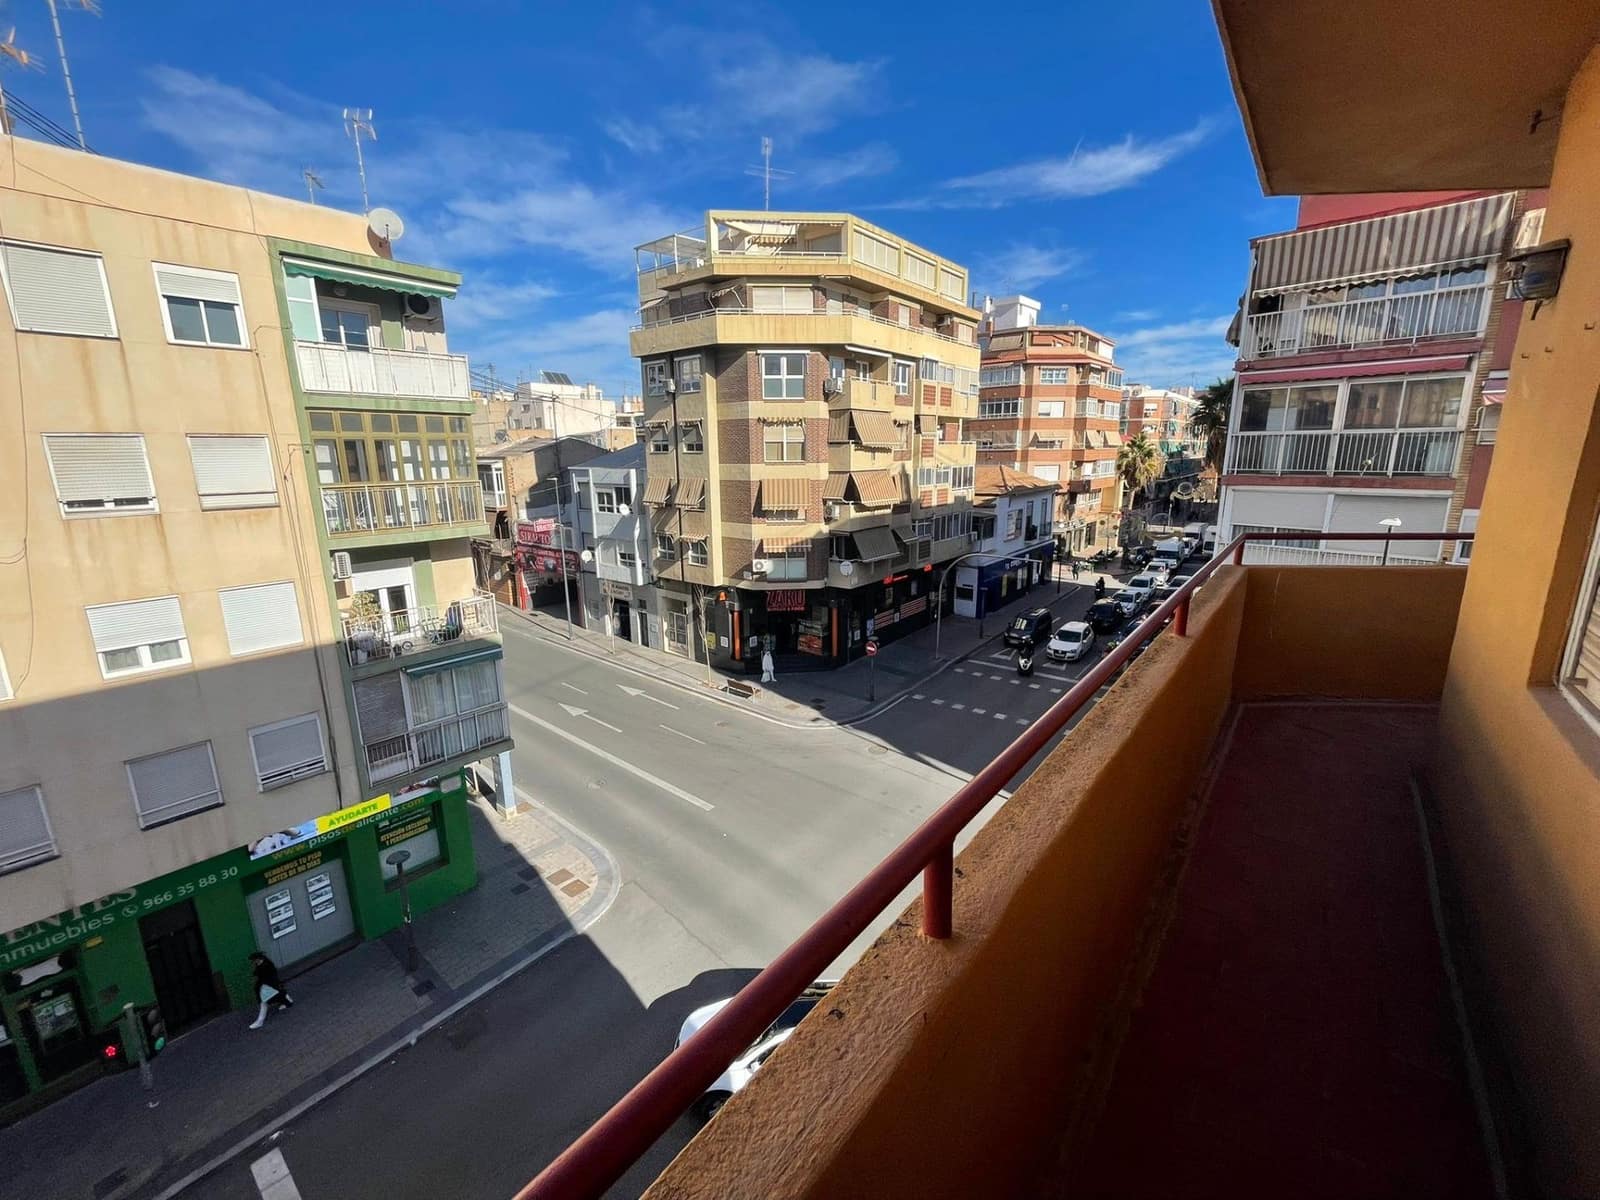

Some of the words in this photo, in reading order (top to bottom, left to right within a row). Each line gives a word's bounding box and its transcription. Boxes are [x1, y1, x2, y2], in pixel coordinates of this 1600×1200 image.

[328, 803, 378, 827] AYUDARTE
[143, 891, 174, 909] 966
[177, 882, 195, 898] 35
[199, 874, 218, 888] 88
[221, 866, 238, 880] 30
